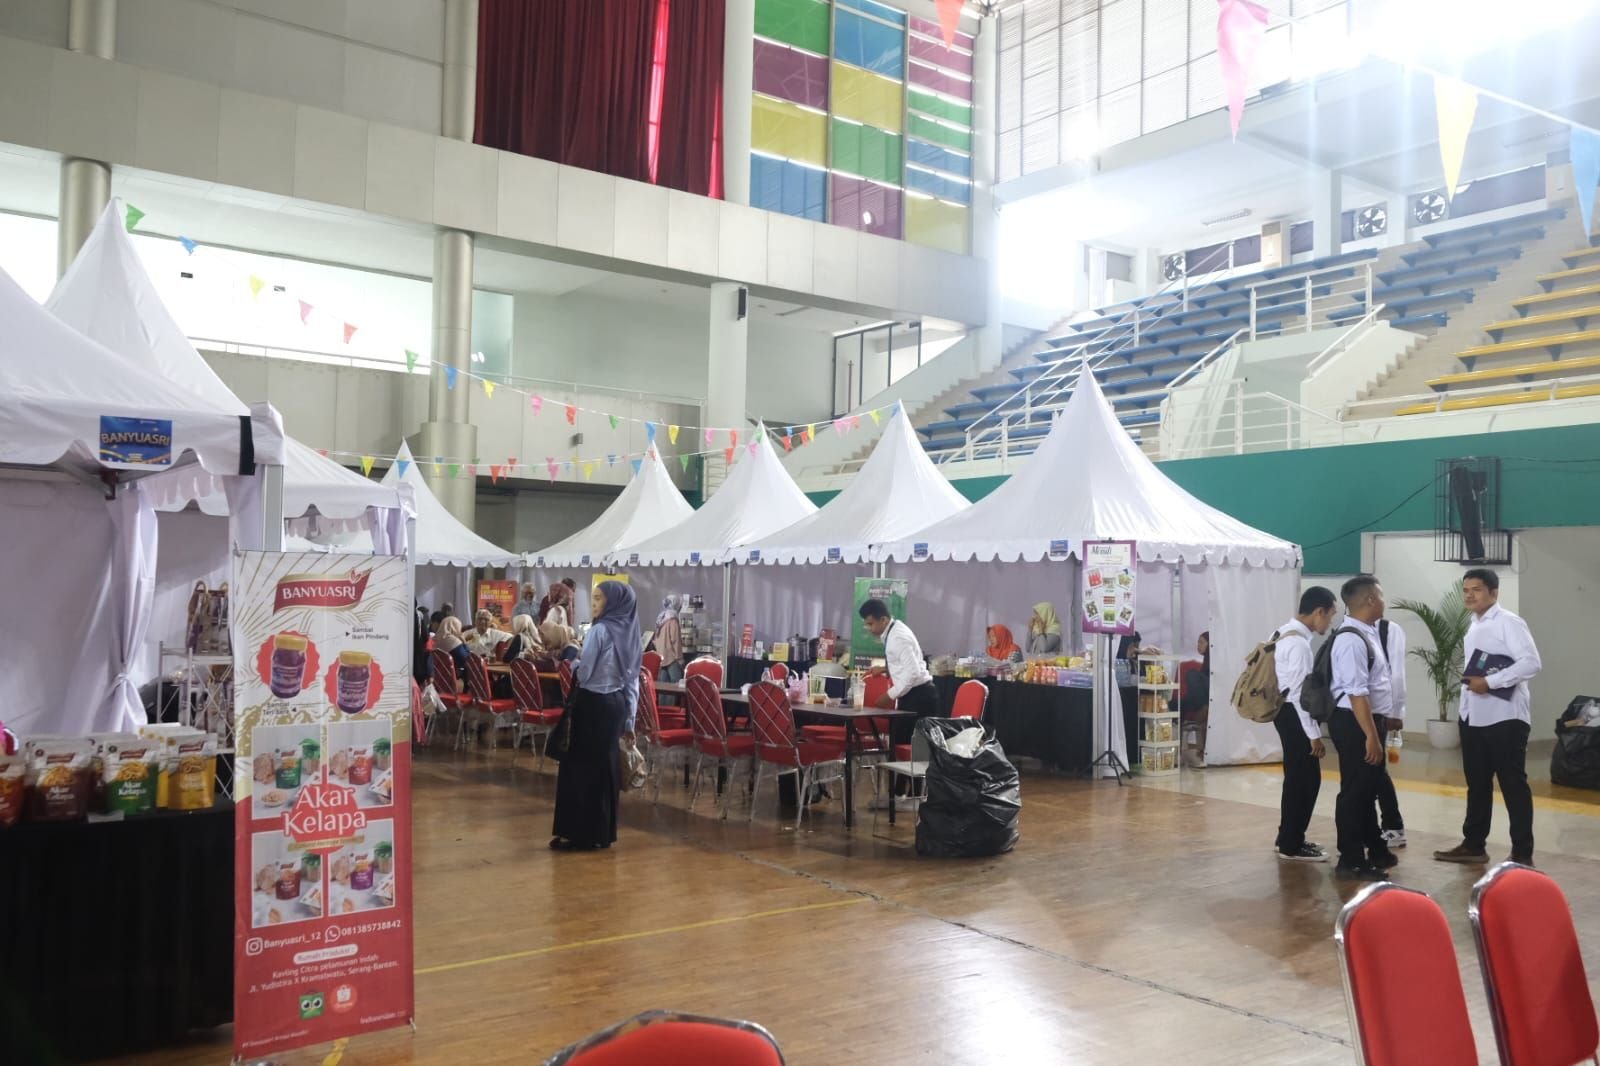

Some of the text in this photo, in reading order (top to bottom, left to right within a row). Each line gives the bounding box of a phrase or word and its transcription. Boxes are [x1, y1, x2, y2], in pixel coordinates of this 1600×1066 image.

[101, 432, 169, 446] BANYUASRI
[282, 586, 356, 600] BANYUASRI
[296, 785, 355, 809] Akar
[284, 810, 366, 835] Kelapa
[263, 931, 321, 949] Banyuasri_12
[272, 967, 299, 979] Kavling
[300, 963, 319, 974] Citra
